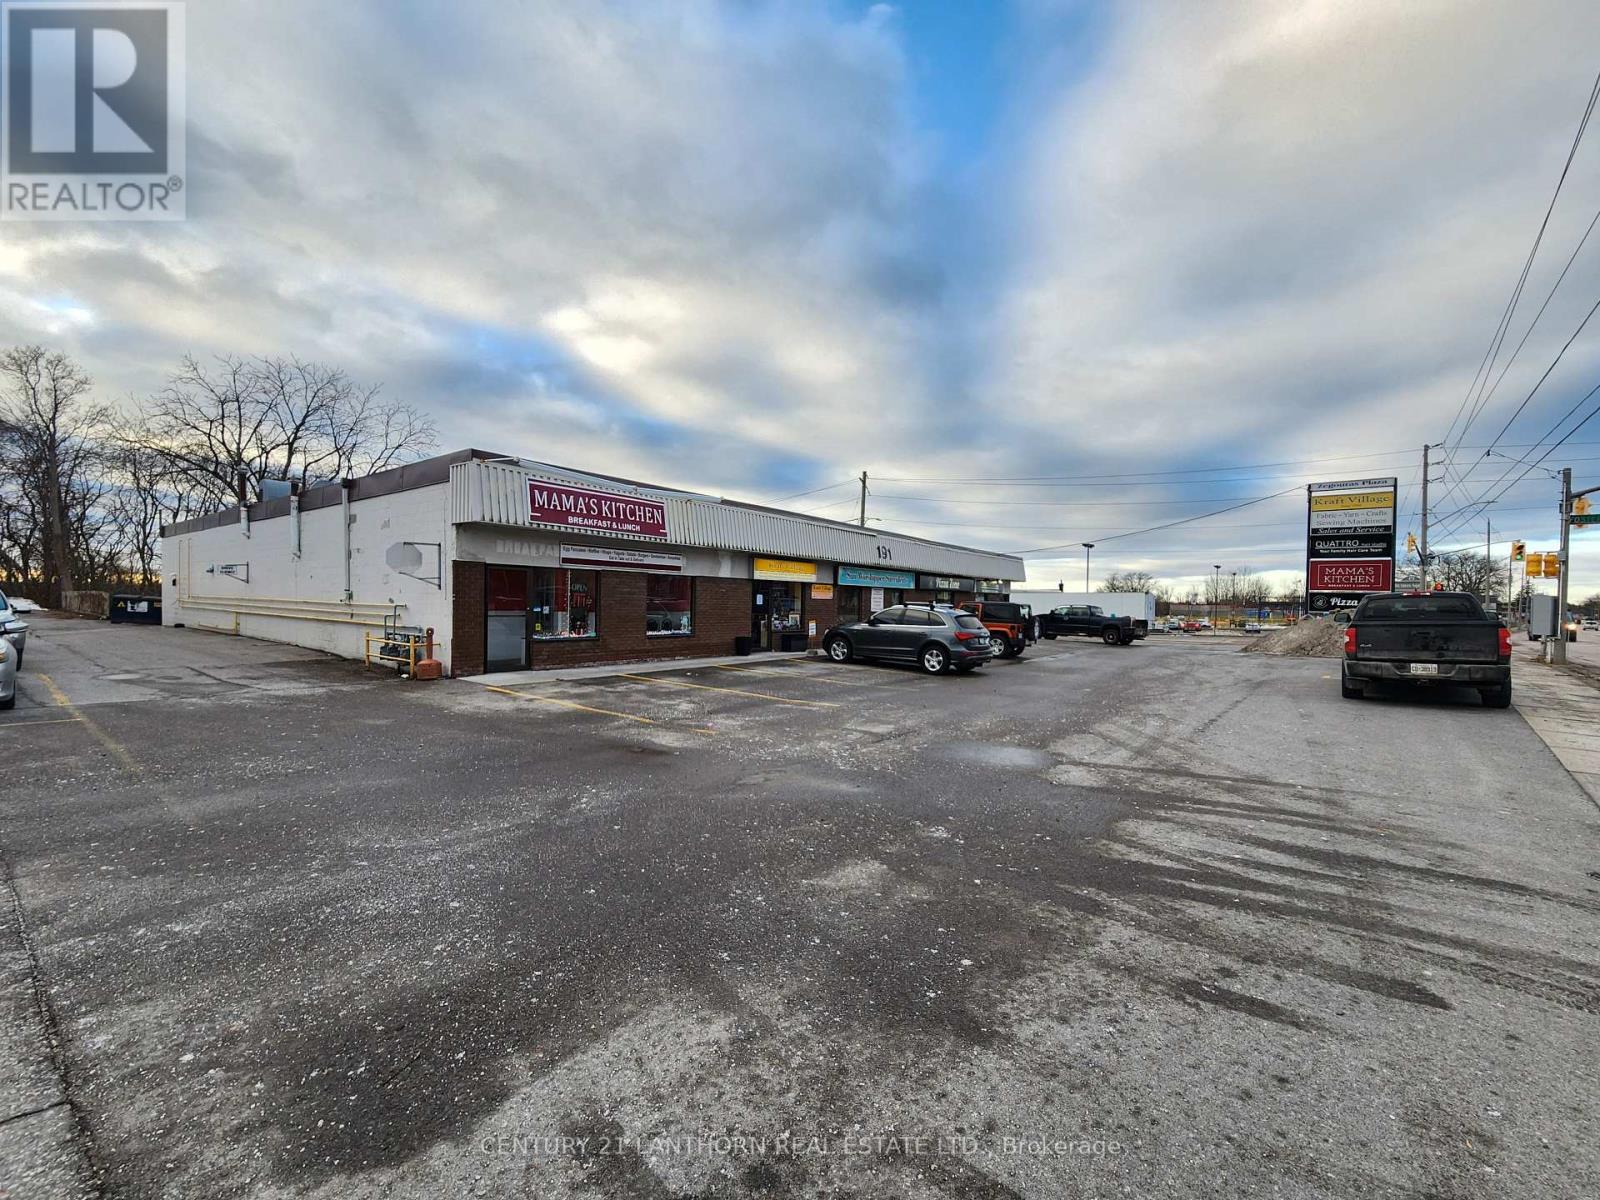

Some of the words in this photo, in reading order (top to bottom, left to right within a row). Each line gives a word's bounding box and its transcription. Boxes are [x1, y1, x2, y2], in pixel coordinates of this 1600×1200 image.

[1314, 497, 1345, 505] Kraft
[1347, 495, 1390, 504] Village
[533, 489, 599, 516] MAMA'S
[601, 500, 663, 525] KITCHEN
[1316, 511, 1337, 519] Fabric
[1365, 509, 1387, 517] Crafts
[568, 515, 612, 529] BREAKFAST
[612, 521, 618, 529] &
[618, 522, 641, 532] LUNCH
[1347, 517, 1387, 525] Machines
[1355, 525, 1385, 533] Service
[1315, 539, 1359, 548] QUATTRO
[876, 545, 892, 560] 191
[1325, 567, 1375, 575] MAMA'S
[1324, 575, 1375, 583] KITCHEN
[1330, 598, 1358, 606] Pizza
